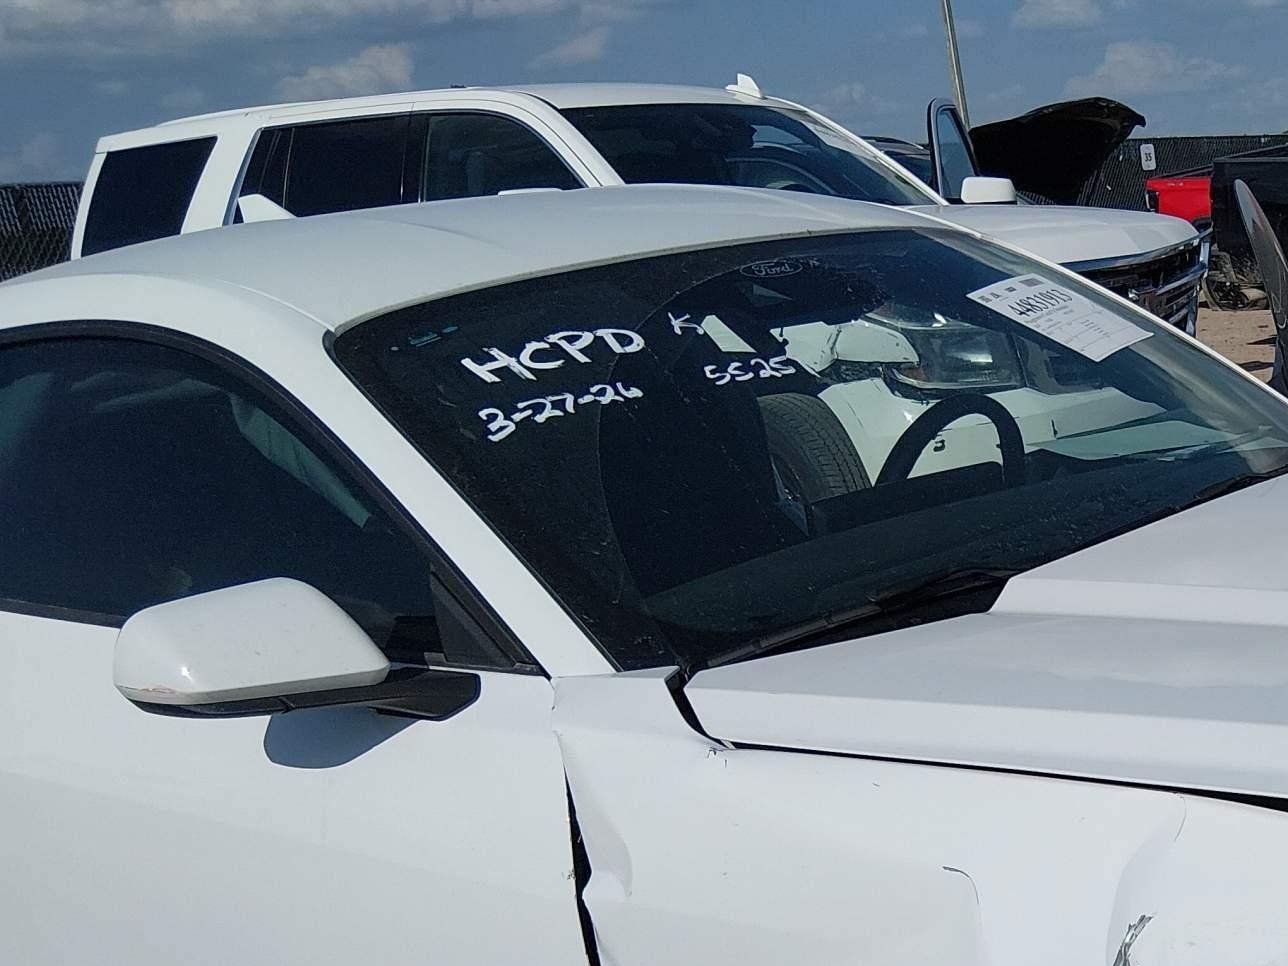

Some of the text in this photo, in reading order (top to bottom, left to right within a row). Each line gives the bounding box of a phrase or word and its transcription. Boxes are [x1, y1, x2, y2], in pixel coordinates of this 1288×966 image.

[751, 263, 794, 275] Ford
[1007, 289, 1073, 317] 44831913
[460, 328, 646, 383] HCPD
[477, 382, 645, 442] 3-27-26
